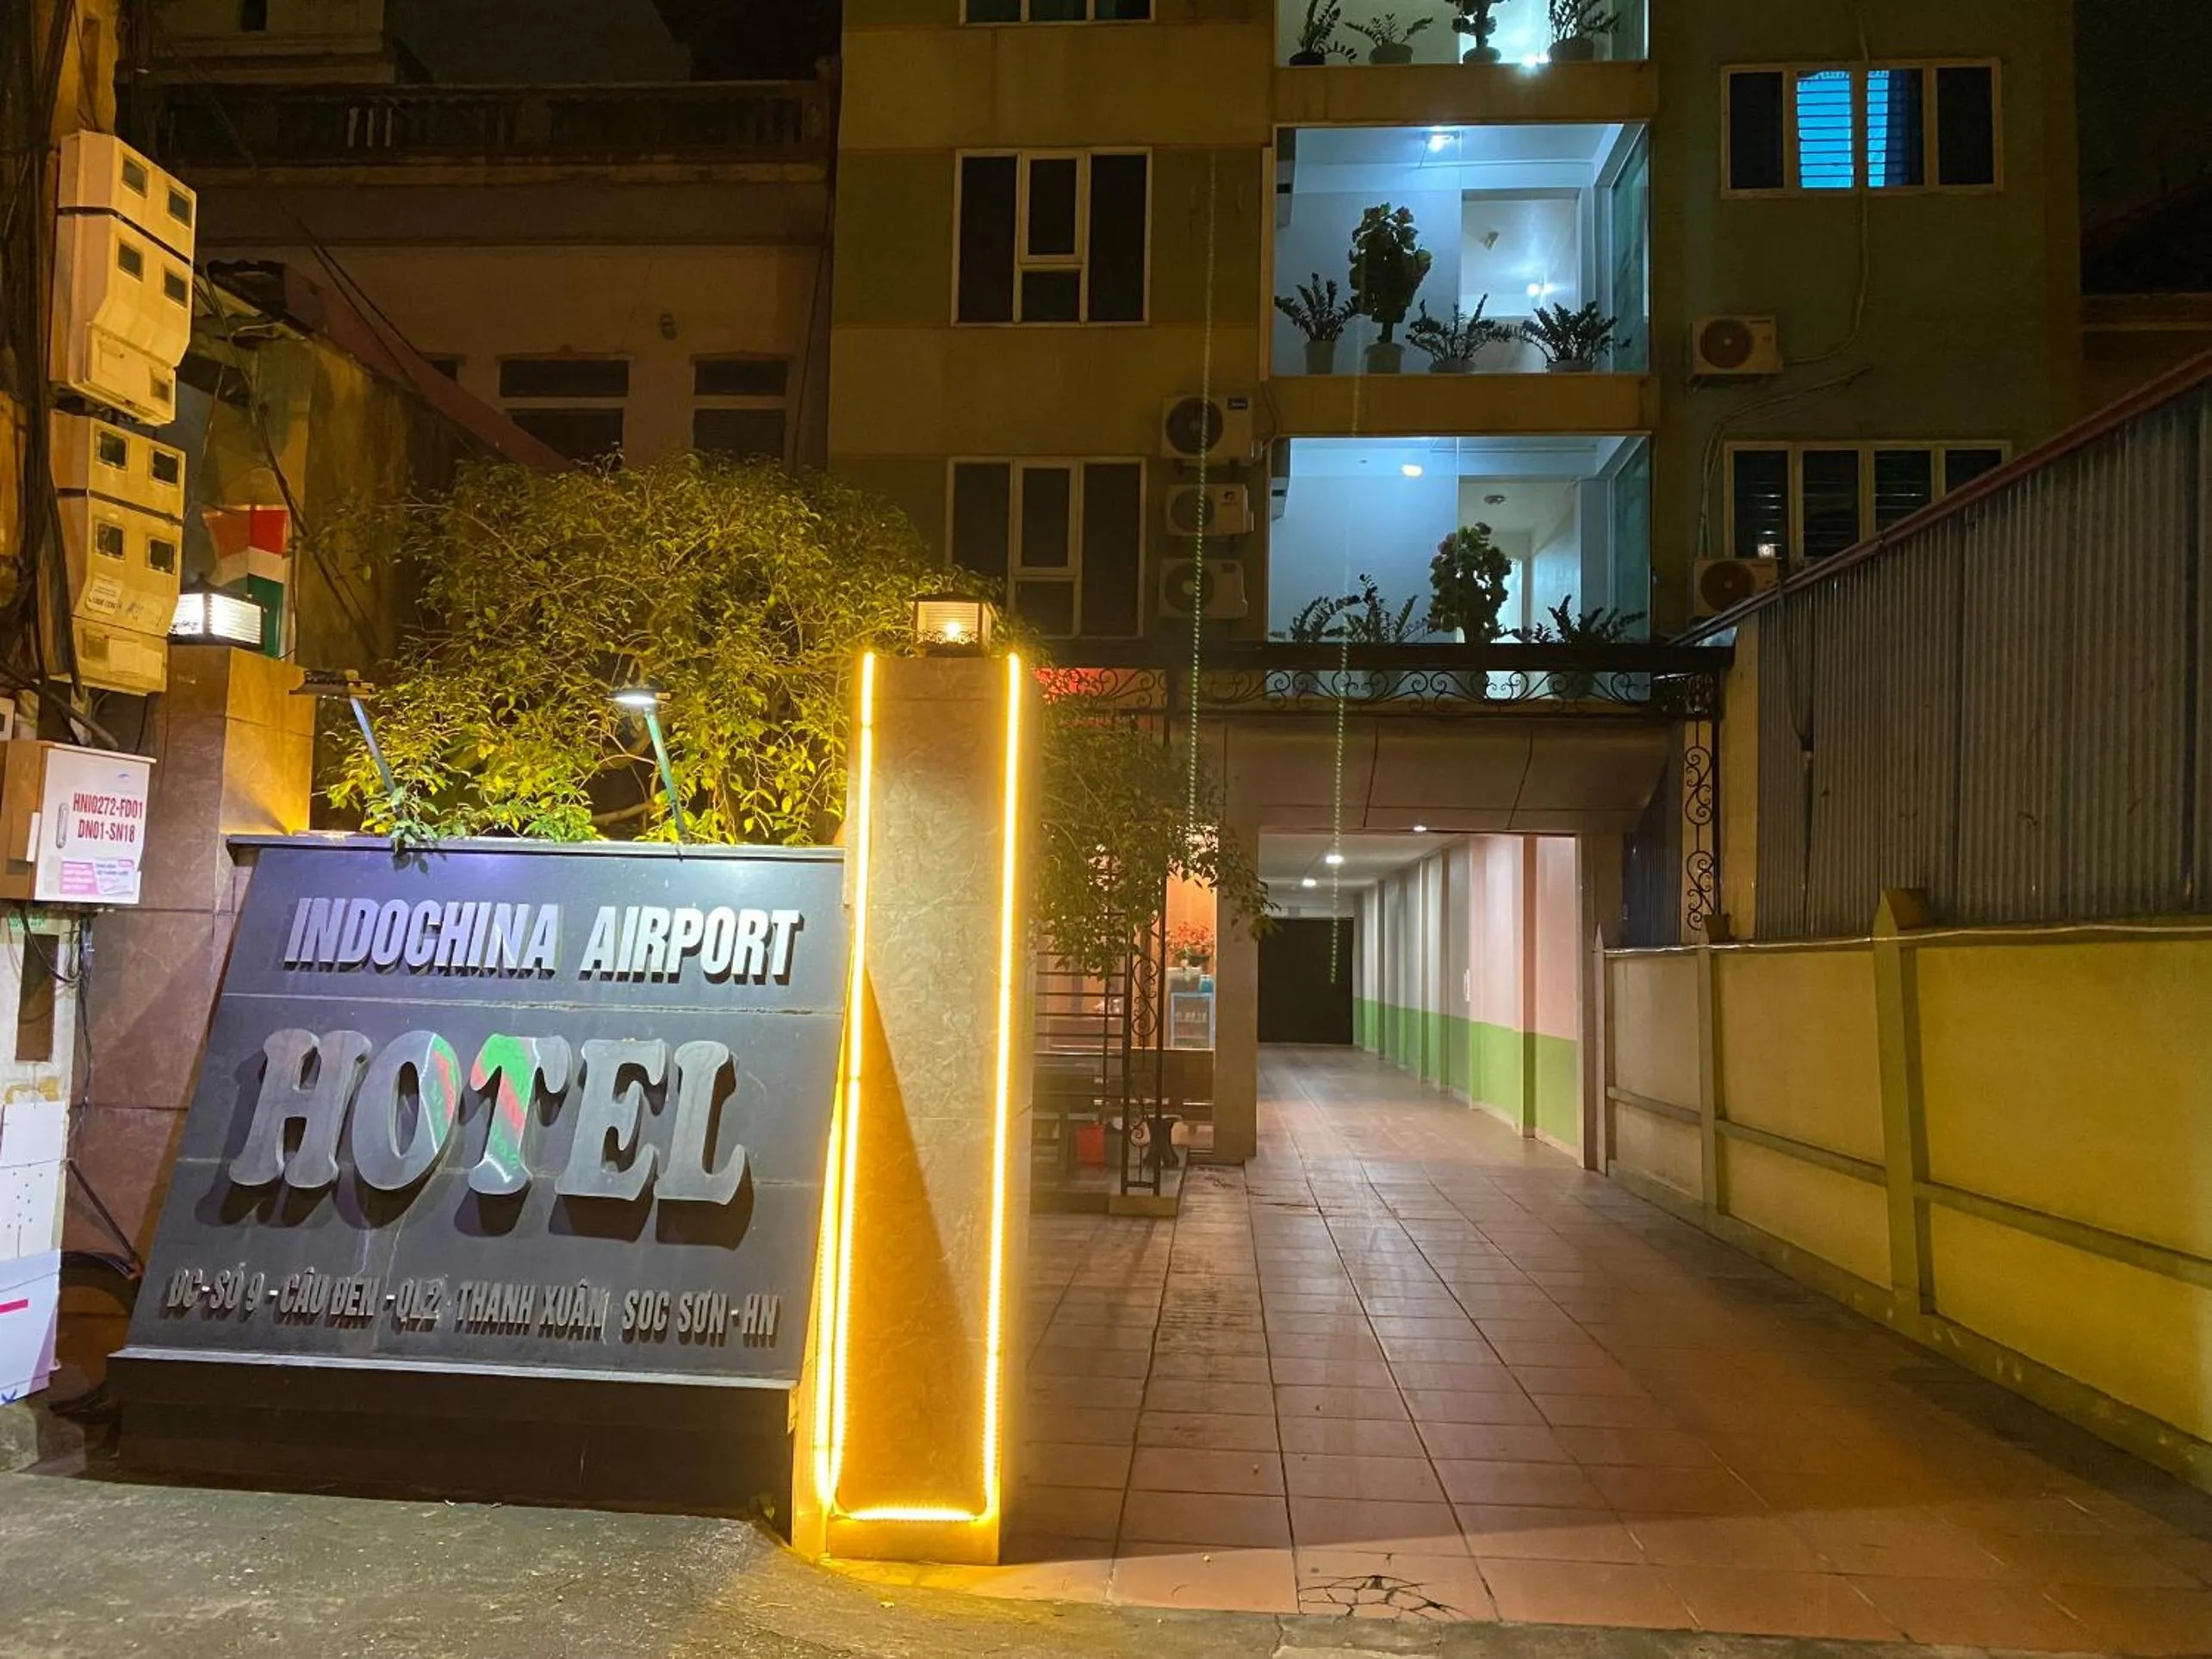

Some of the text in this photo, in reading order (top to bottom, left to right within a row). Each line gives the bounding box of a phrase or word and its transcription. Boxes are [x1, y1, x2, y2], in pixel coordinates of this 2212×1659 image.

[78, 819, 135, 842] DN01-SN18
[283, 897, 803, 982] INDOCHINA AIRPORT
[228, 1028, 748, 1205] HOTEL
[456, 1281, 538, 1324] THANH
